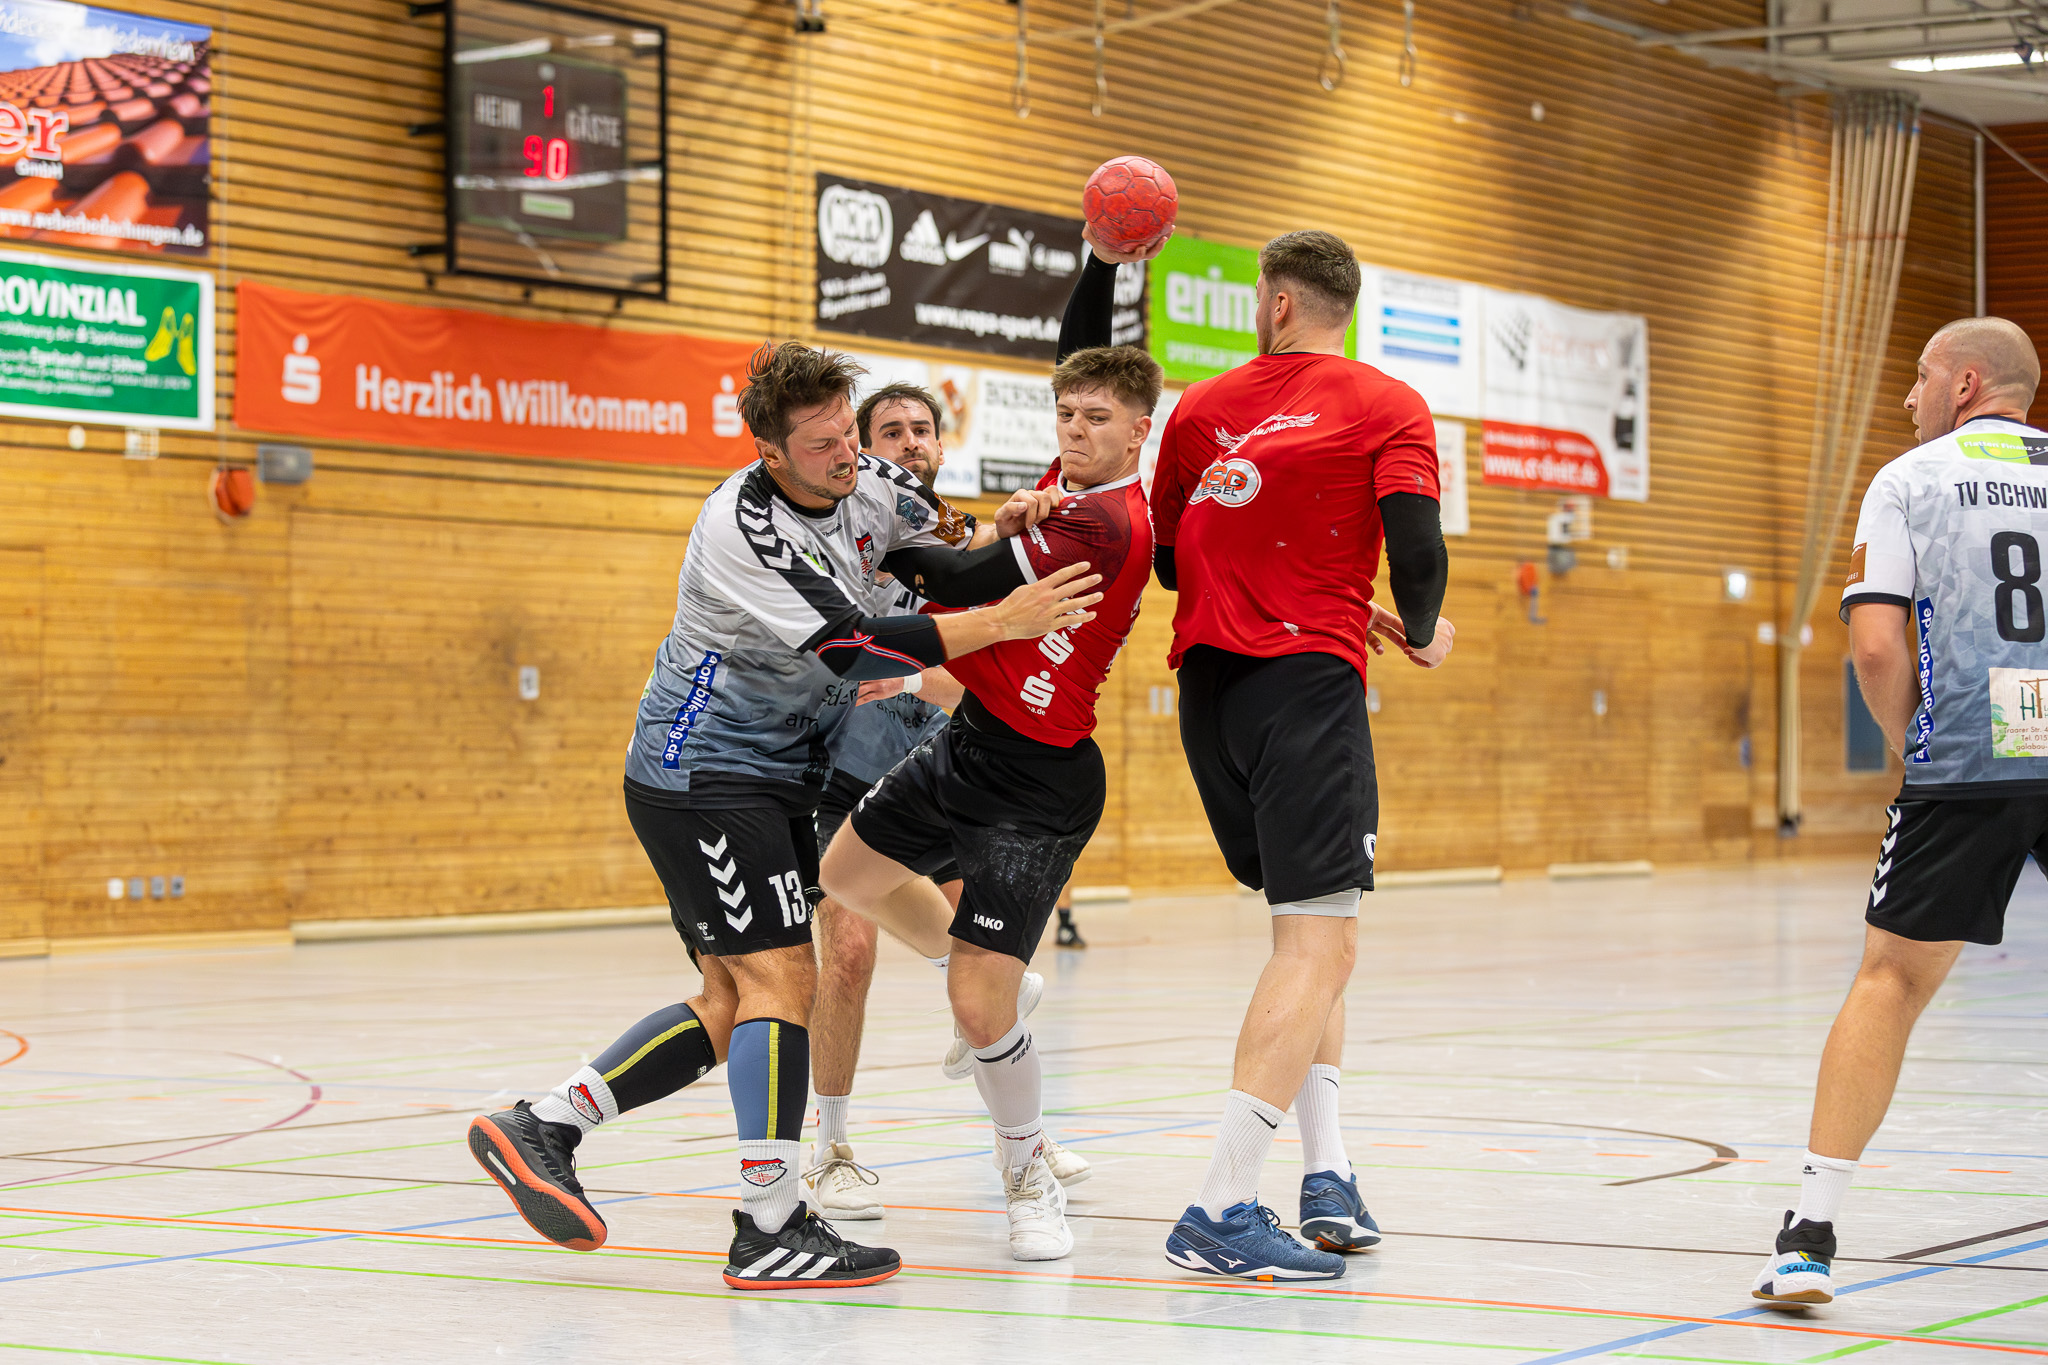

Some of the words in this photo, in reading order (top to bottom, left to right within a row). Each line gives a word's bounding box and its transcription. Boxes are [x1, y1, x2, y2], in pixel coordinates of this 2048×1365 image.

[474, 93, 522, 131] HEIM
[565, 104, 621, 148] GÄSTE
[542, 85, 554, 118] 1
[1165, 266, 1257, 334] erim
[356, 363, 492, 422] Herzlich
[498, 378, 688, 436] Willkommen
[1954, 481, 1978, 507] TV
[1985, 481, 2048, 509] SCHW
[1990, 530, 2046, 643] 8
[768, 870, 807, 928] 13
[973, 913, 1004, 931] JAKO
